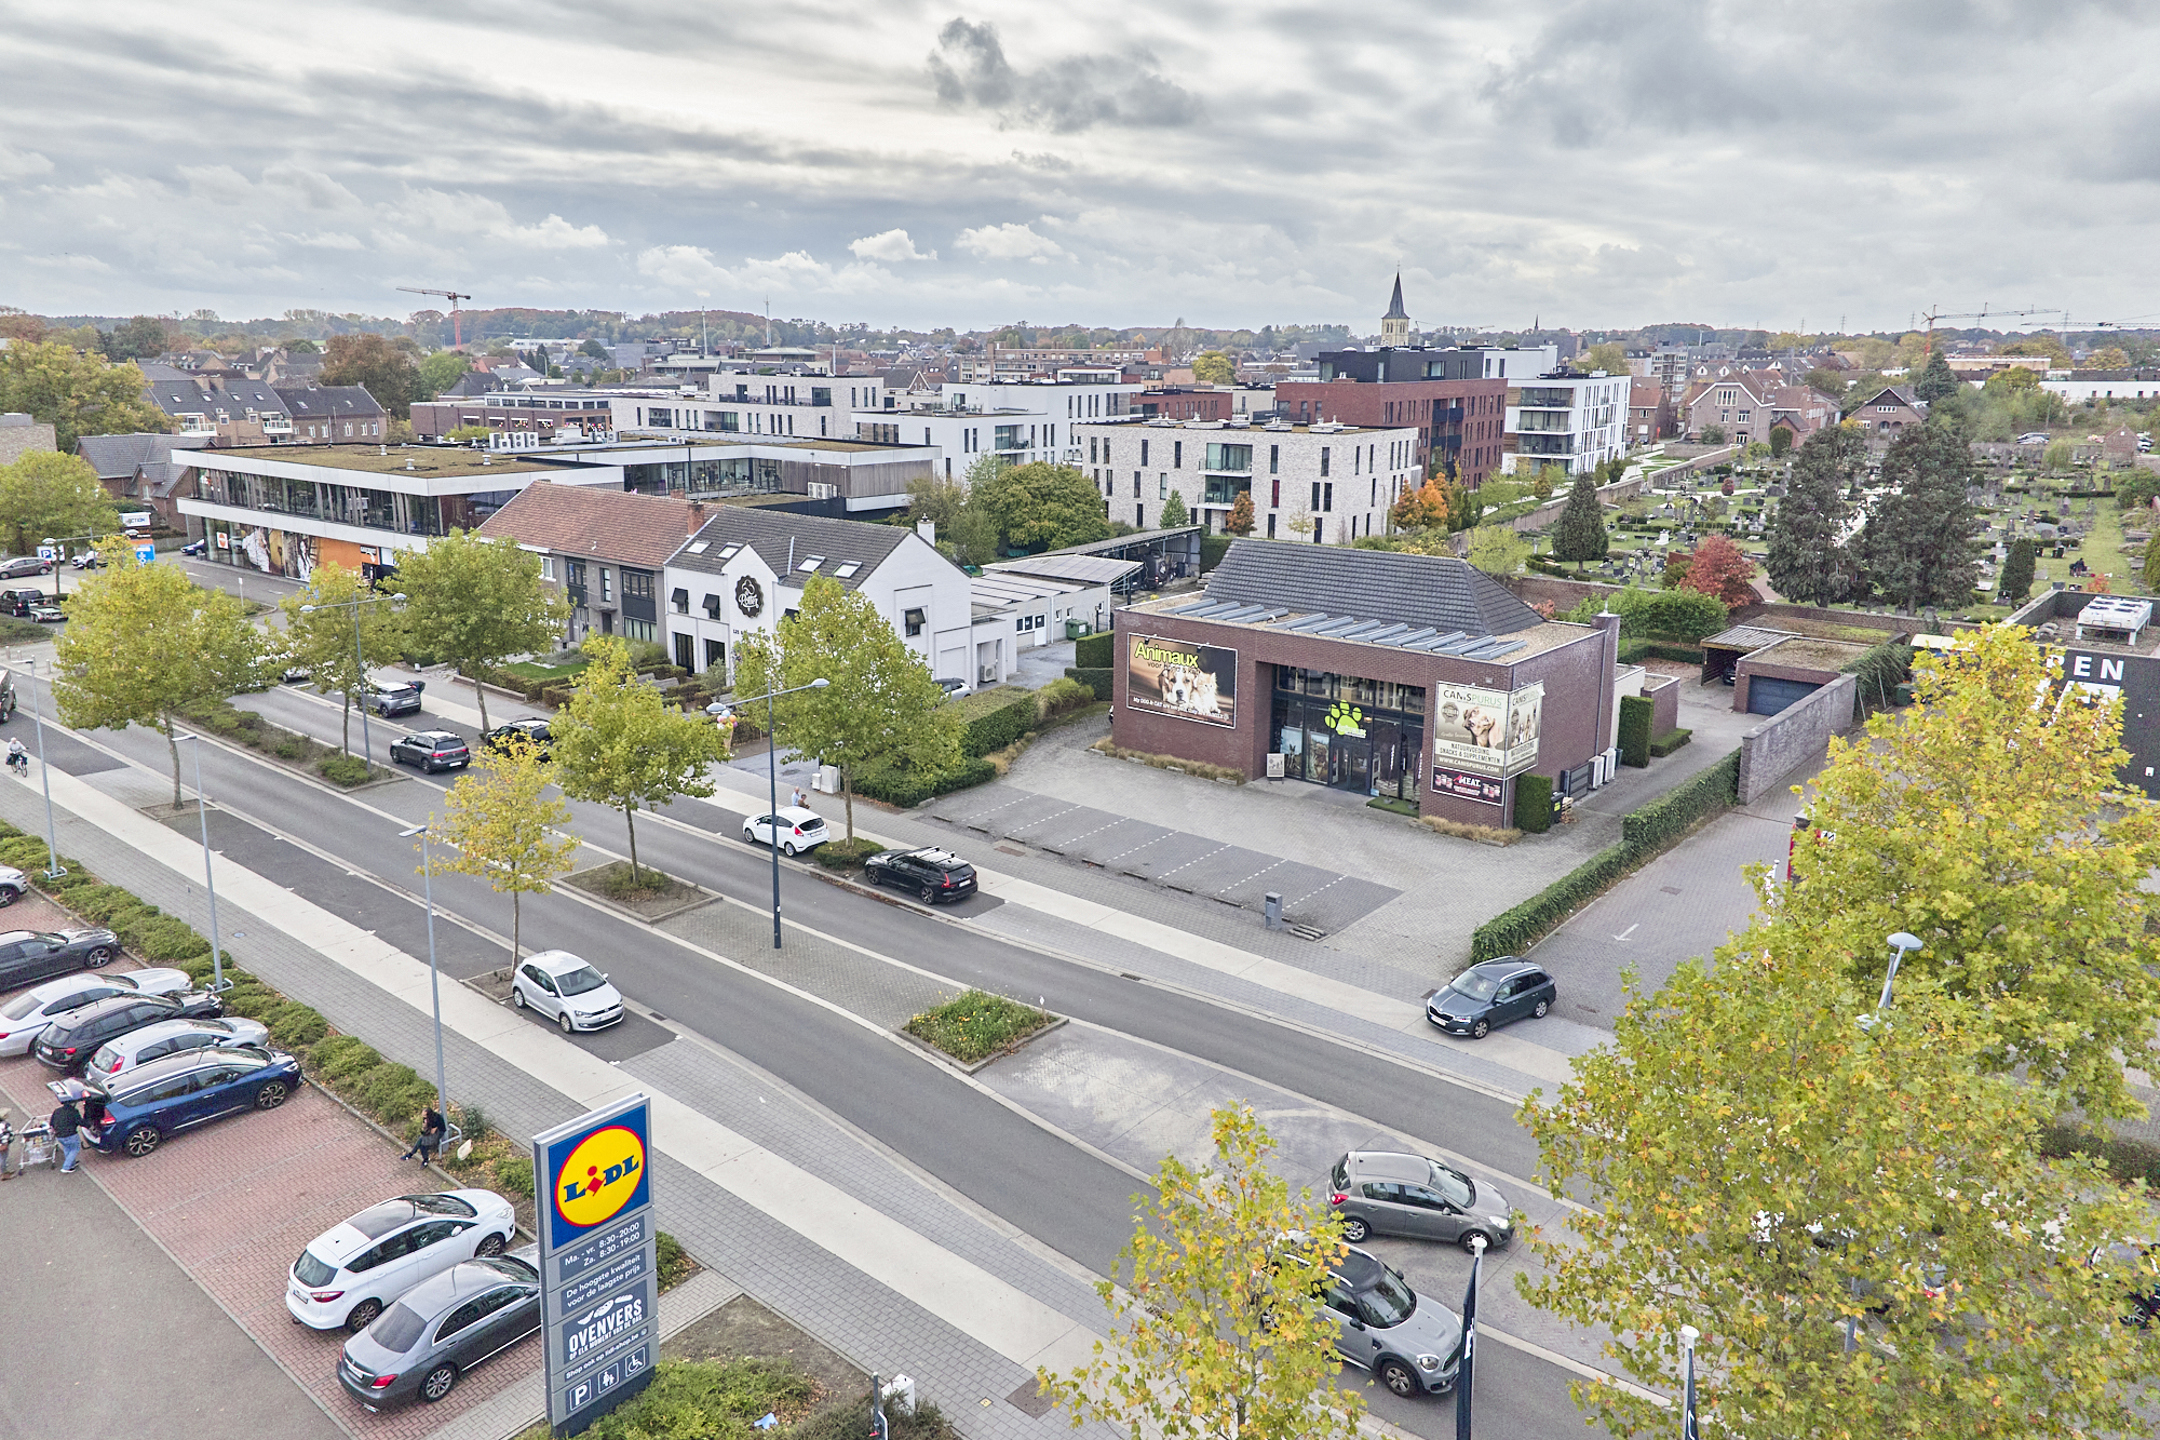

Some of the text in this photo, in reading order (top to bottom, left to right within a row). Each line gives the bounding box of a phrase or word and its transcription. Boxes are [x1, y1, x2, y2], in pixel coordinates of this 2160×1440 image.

[1135, 642, 1199, 668] Animaux
[565, 1255, 580, 1266] Ma.
[585, 1246, 596, 1255] vr.
[566, 1254, 641, 1298] De hoogste kwaliteit
[583, 1257, 596, 1267] Za.
[567, 1264, 640, 1308] voor de laagste prijs
[569, 1298, 642, 1353] OVENVERS
[569, 1314, 642, 1360] OP ELK MOMENT VAN DE DAG
[566, 1333, 639, 1379] Shop ook op lidl-shop.be
[575, 1385, 587, 1405] P
